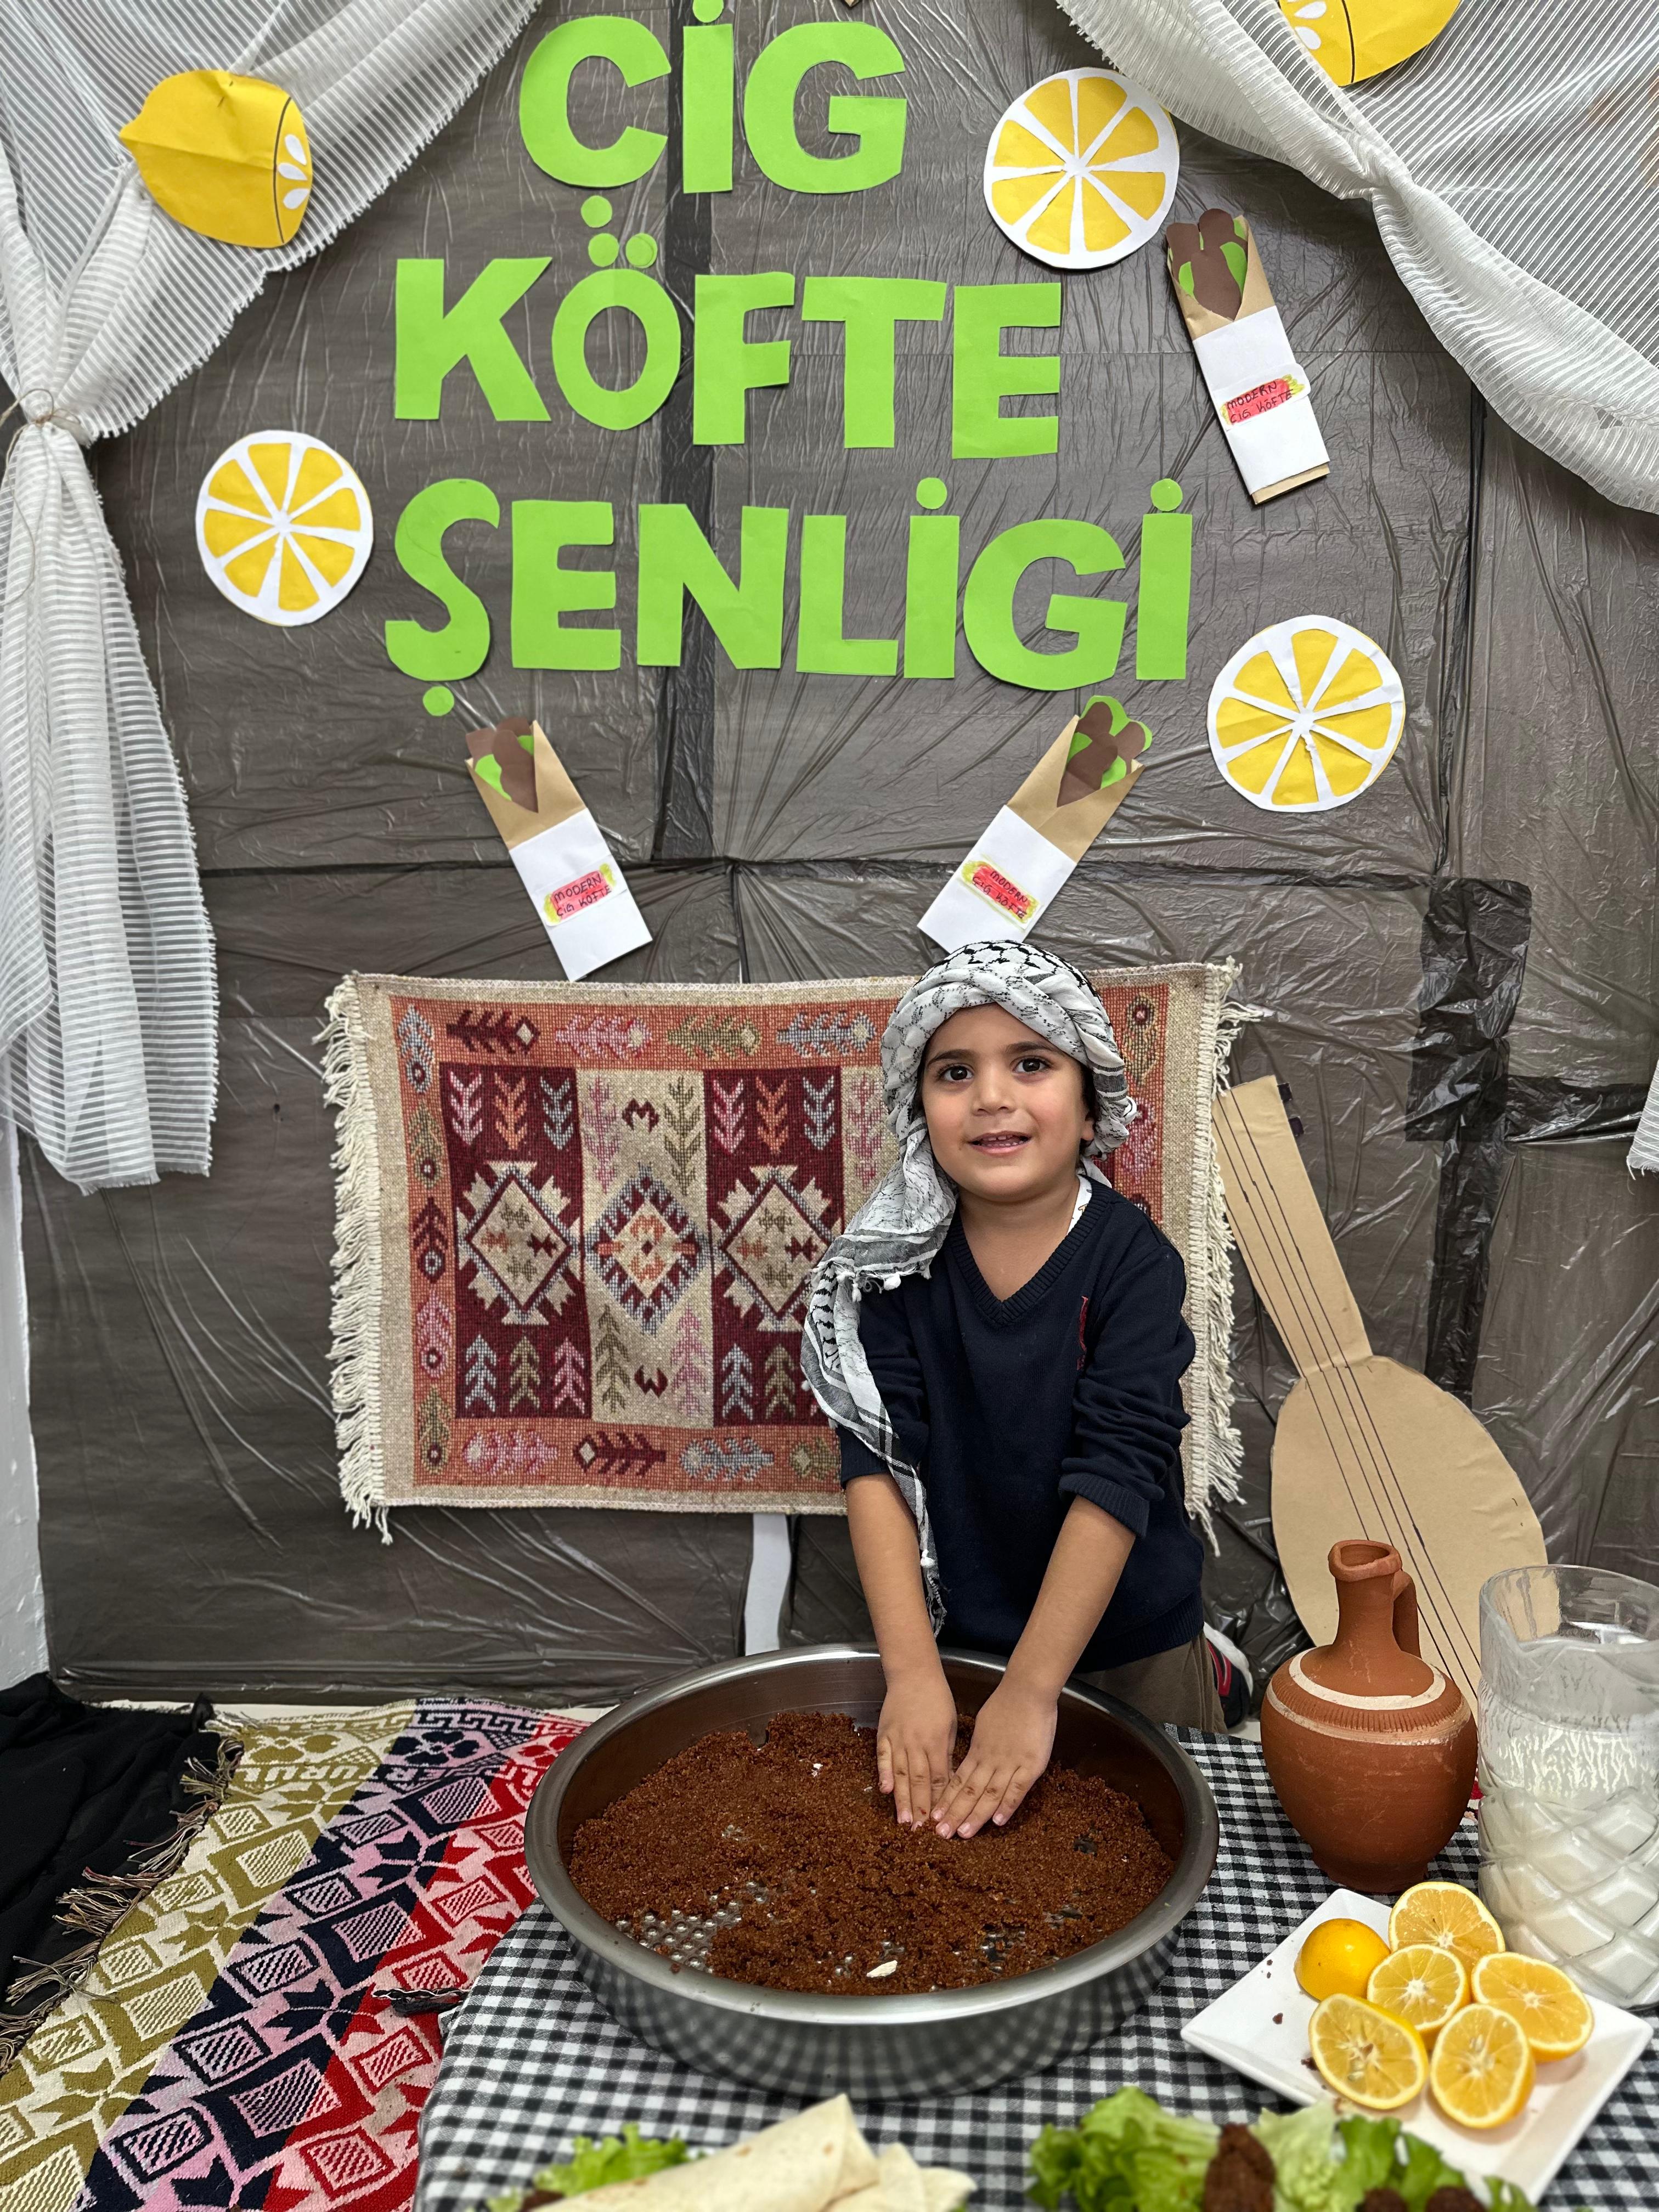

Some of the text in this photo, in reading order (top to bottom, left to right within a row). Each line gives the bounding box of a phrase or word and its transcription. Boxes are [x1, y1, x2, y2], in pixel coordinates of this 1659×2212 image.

[394, 233, 1061, 460] KÖFTE
[1227, 381, 1277, 410] MODERN
[384, 478, 1193, 715] ŞENLİGİ
[554, 873, 602, 904] MODERN
[990, 871, 1028, 903] MODERN
